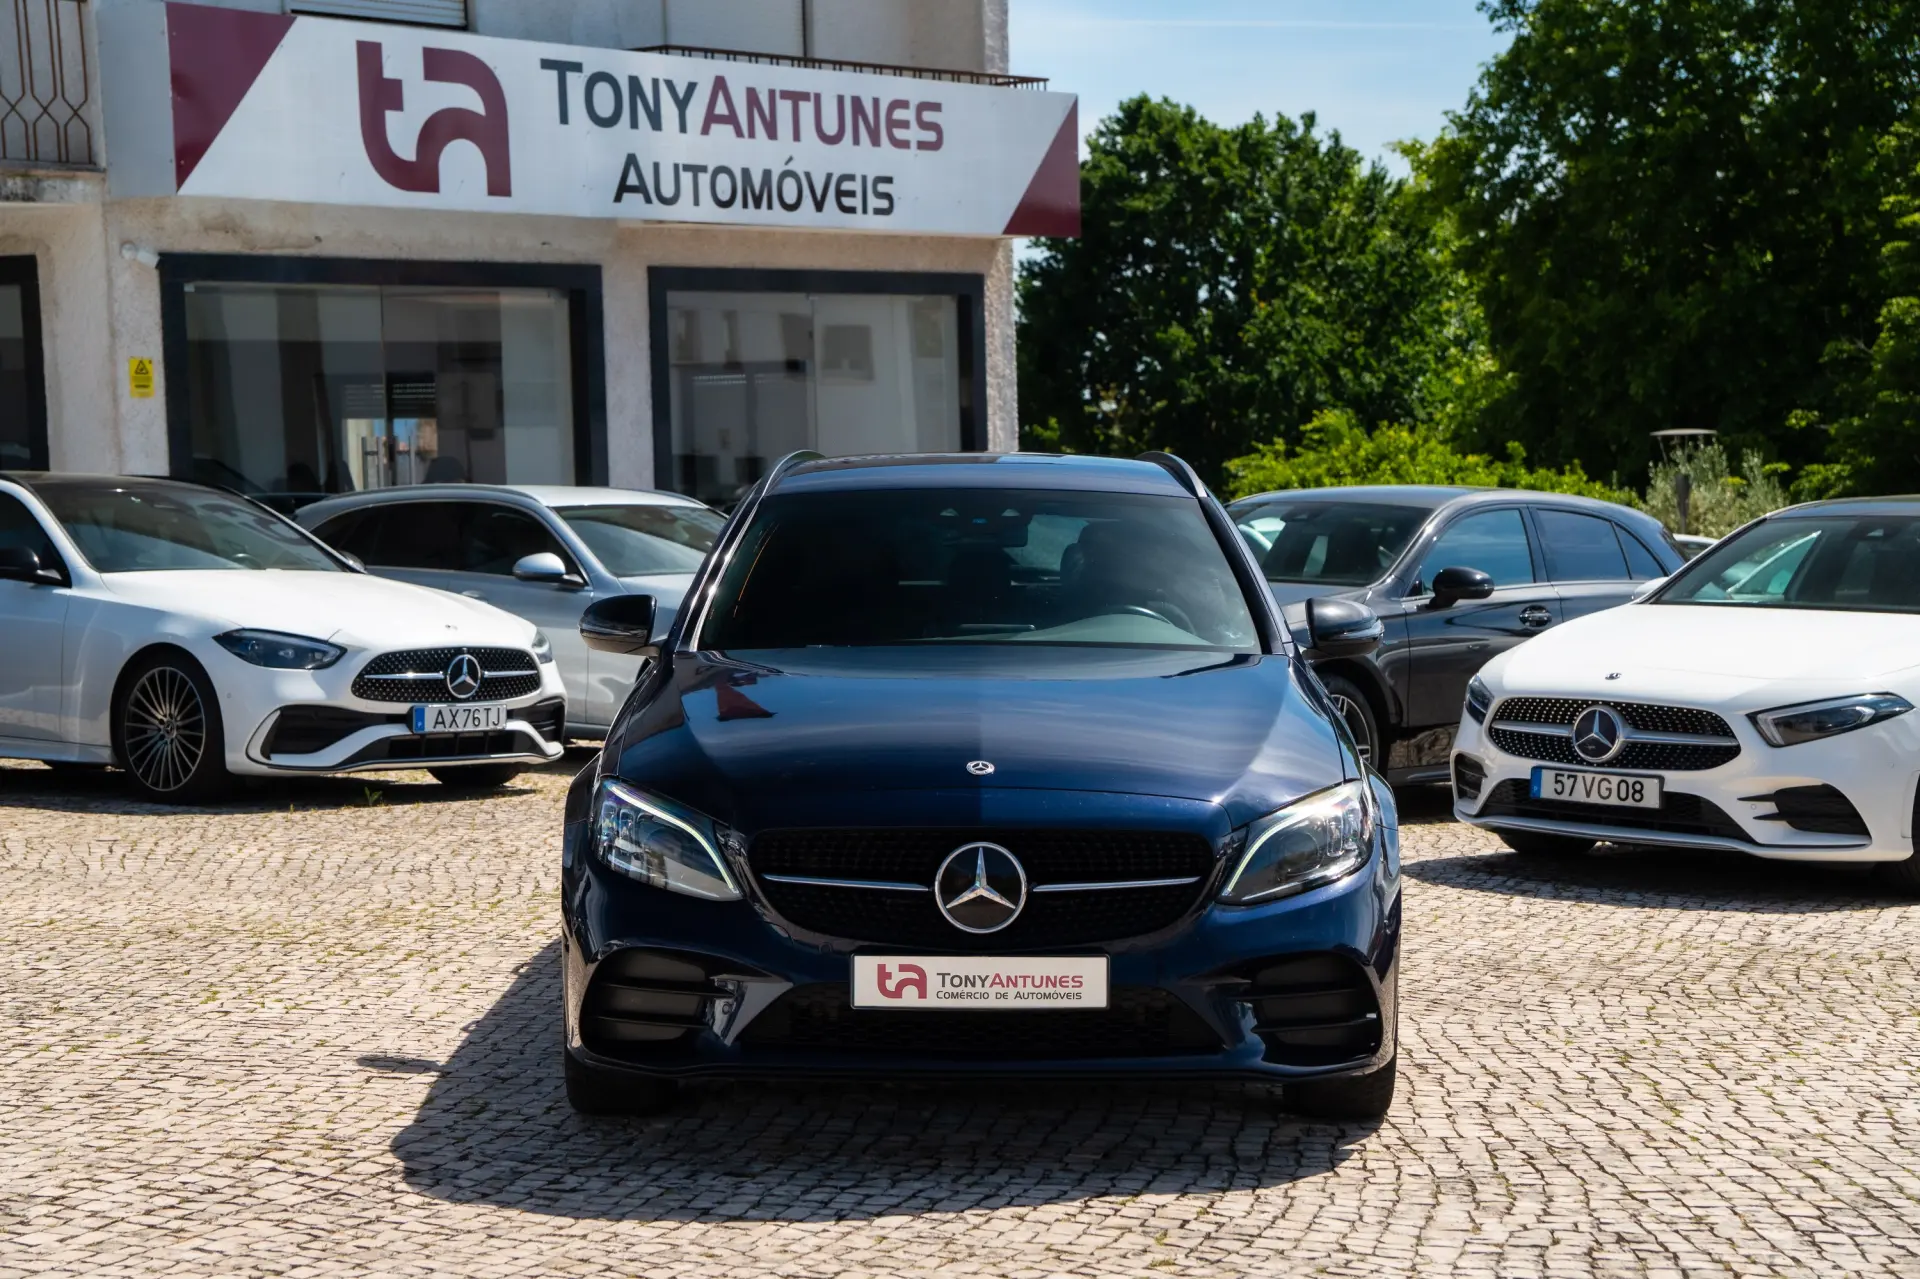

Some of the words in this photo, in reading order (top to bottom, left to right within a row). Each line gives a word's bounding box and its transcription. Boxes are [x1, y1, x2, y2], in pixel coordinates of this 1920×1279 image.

[612, 153, 895, 216] AUTOMÓVEIS
[433, 707, 500, 729] AX76TJ
[1553, 772, 1645, 803] 57VG08
[936, 990, 990, 1000] COMÉRCIO
[995, 991, 1009, 1000] DE
[1014, 990, 1082, 1000] AUTOMÓVEIS
